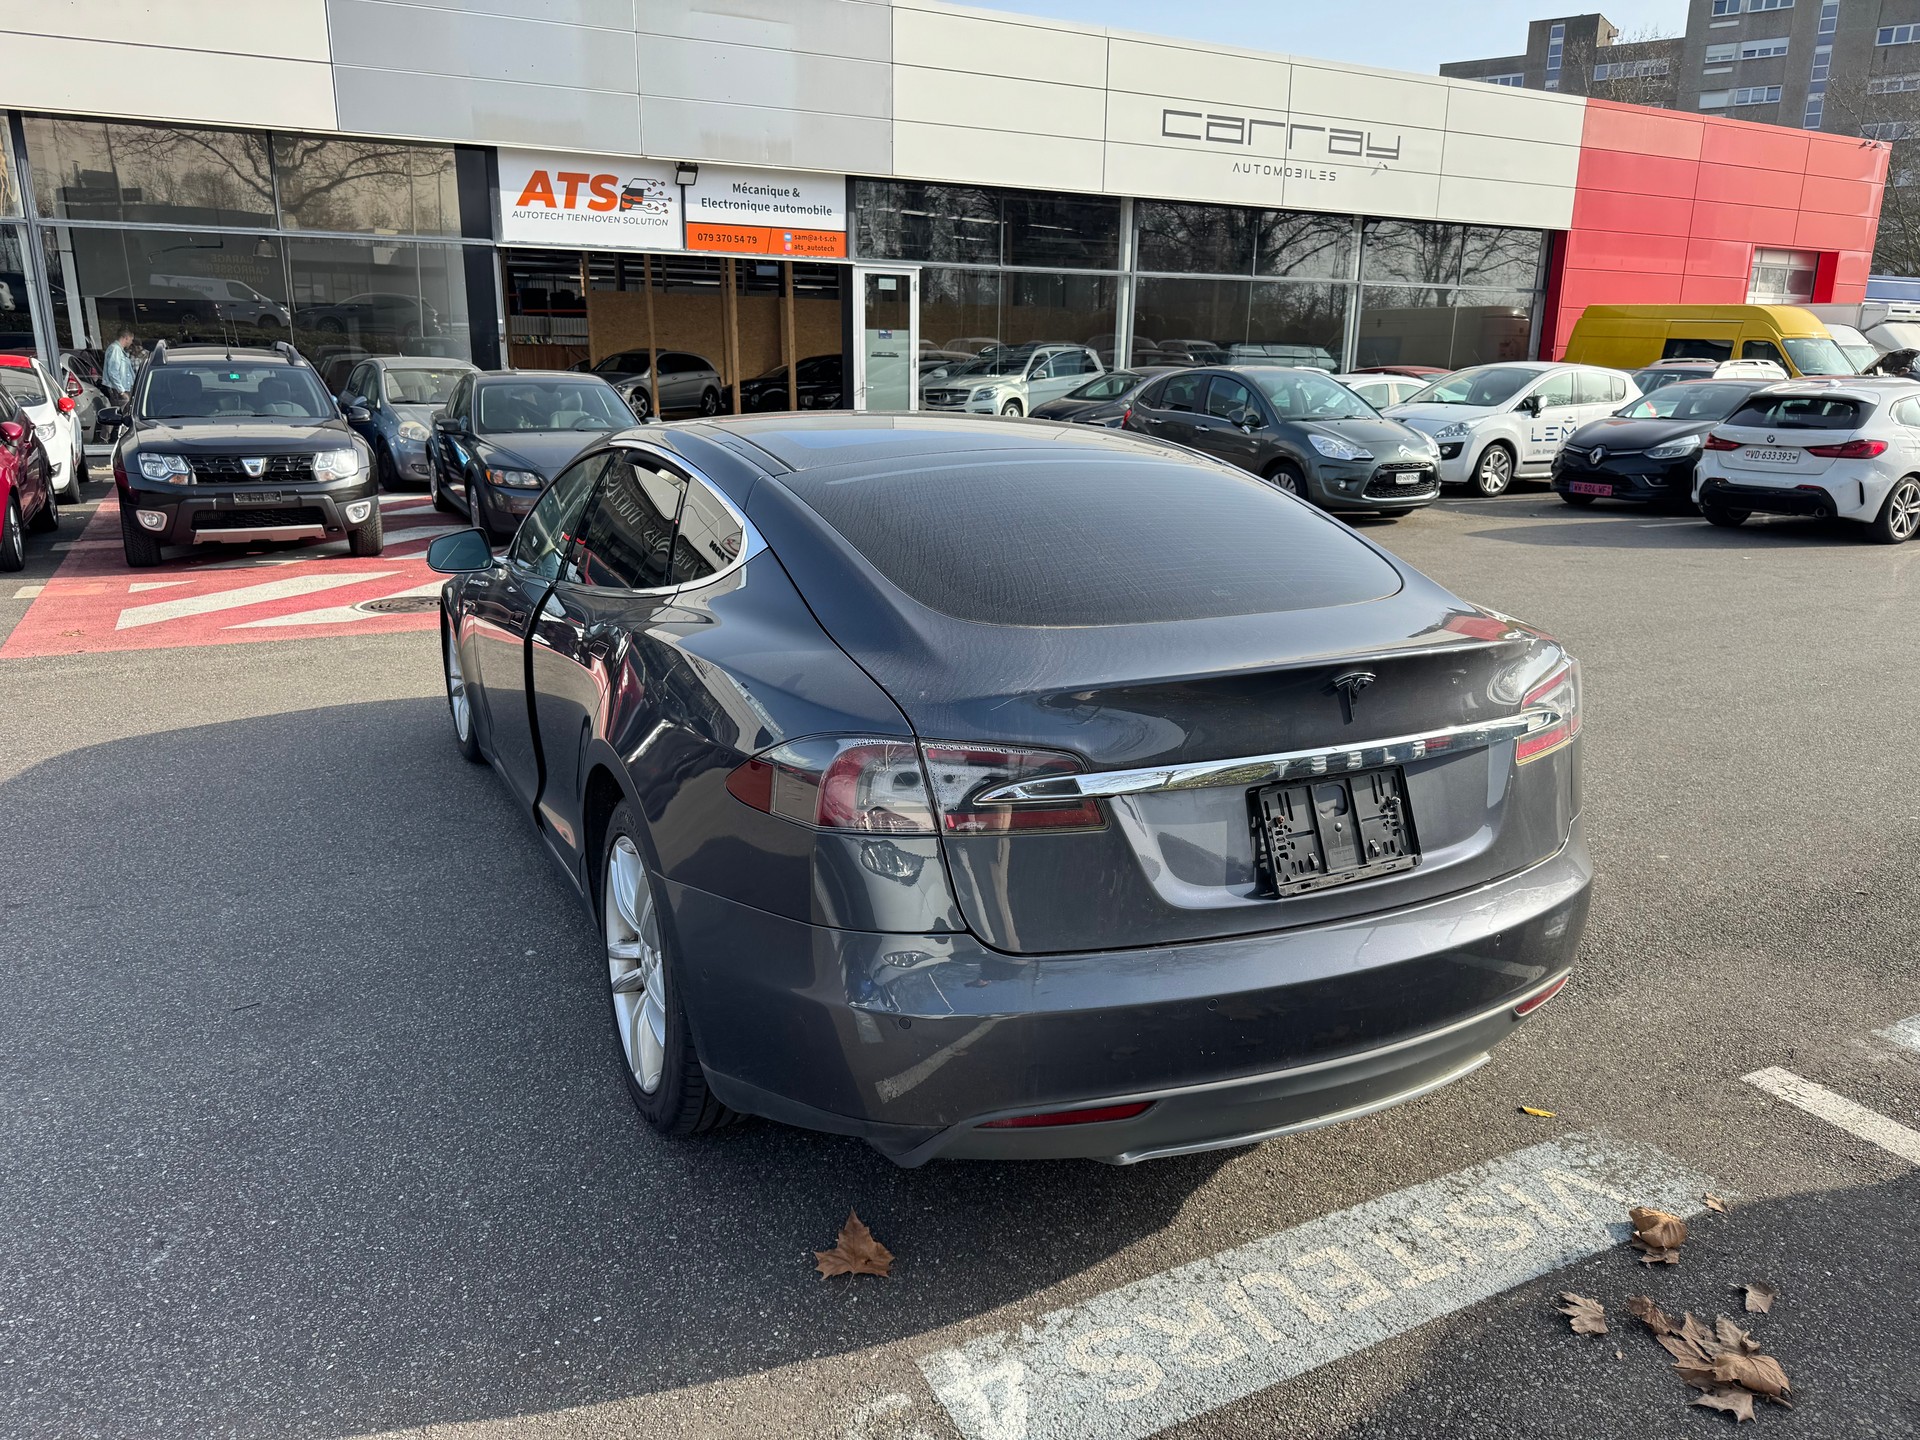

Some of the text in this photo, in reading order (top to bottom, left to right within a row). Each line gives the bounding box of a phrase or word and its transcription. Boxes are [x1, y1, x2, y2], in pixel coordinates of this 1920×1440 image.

[1232, 161, 1337, 182] AUTOMOBILES
[515, 169, 620, 212] ATS
[732, 182, 801, 199] Mécanique &
[701, 197, 833, 217] Electronique automobile
[511, 210, 669, 227] AUTOTECH TIENHOVEN SOLUTION
[697, 232, 757, 244] 079 370 54 79
[794, 243, 835, 252] ats_autotech
[1273, 741, 1426, 778] TESLA
[1064, 1166, 1639, 1402] VISITEURS
